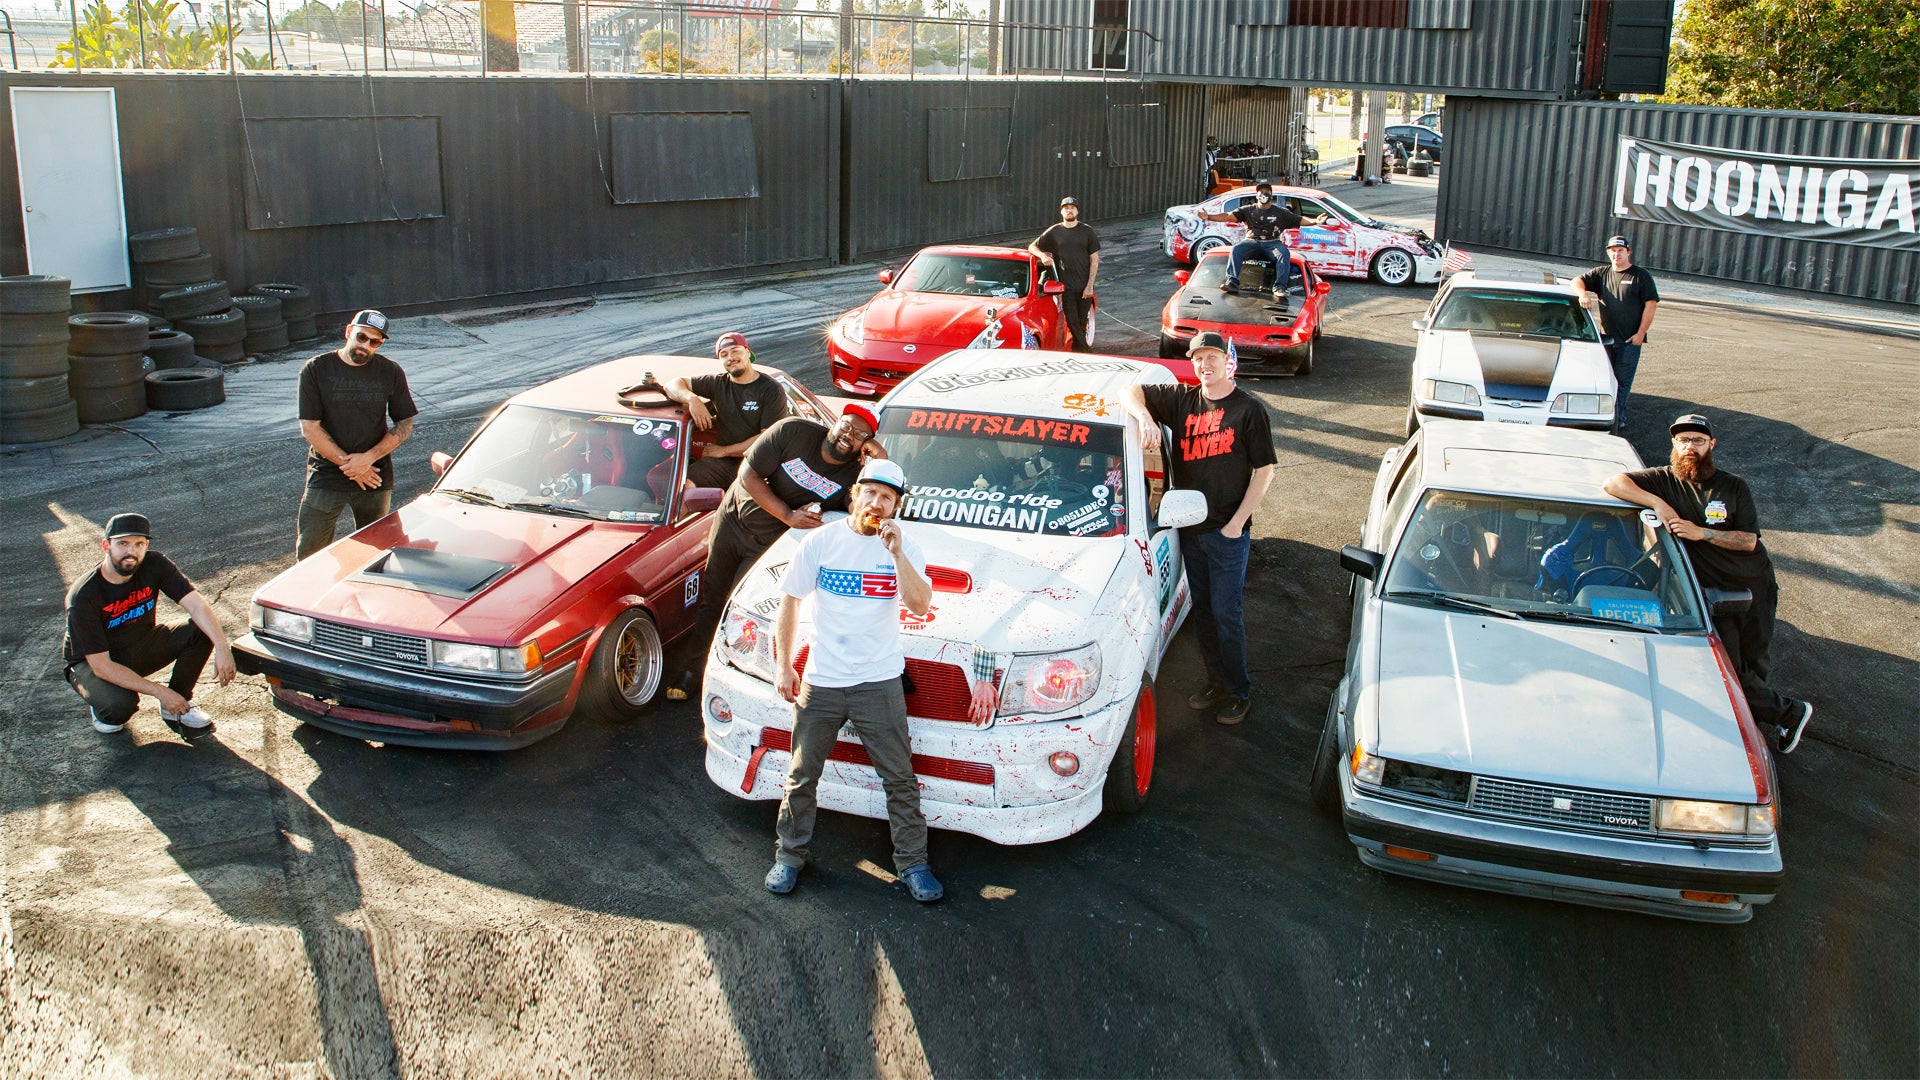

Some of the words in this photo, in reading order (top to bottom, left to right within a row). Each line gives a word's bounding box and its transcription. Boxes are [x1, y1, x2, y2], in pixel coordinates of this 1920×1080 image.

[1614, 139, 1920, 233] [HOONIGA
[907, 410, 1091, 446] DRIFTSLAYER
[1185, 407, 1225, 437] TIRE
[905, 484, 1005, 502] voodoo
[1008, 493, 1063, 509] ride
[395, 651, 420, 662] TOYOTA
[1603, 815, 1639, 827] TOYOTA
